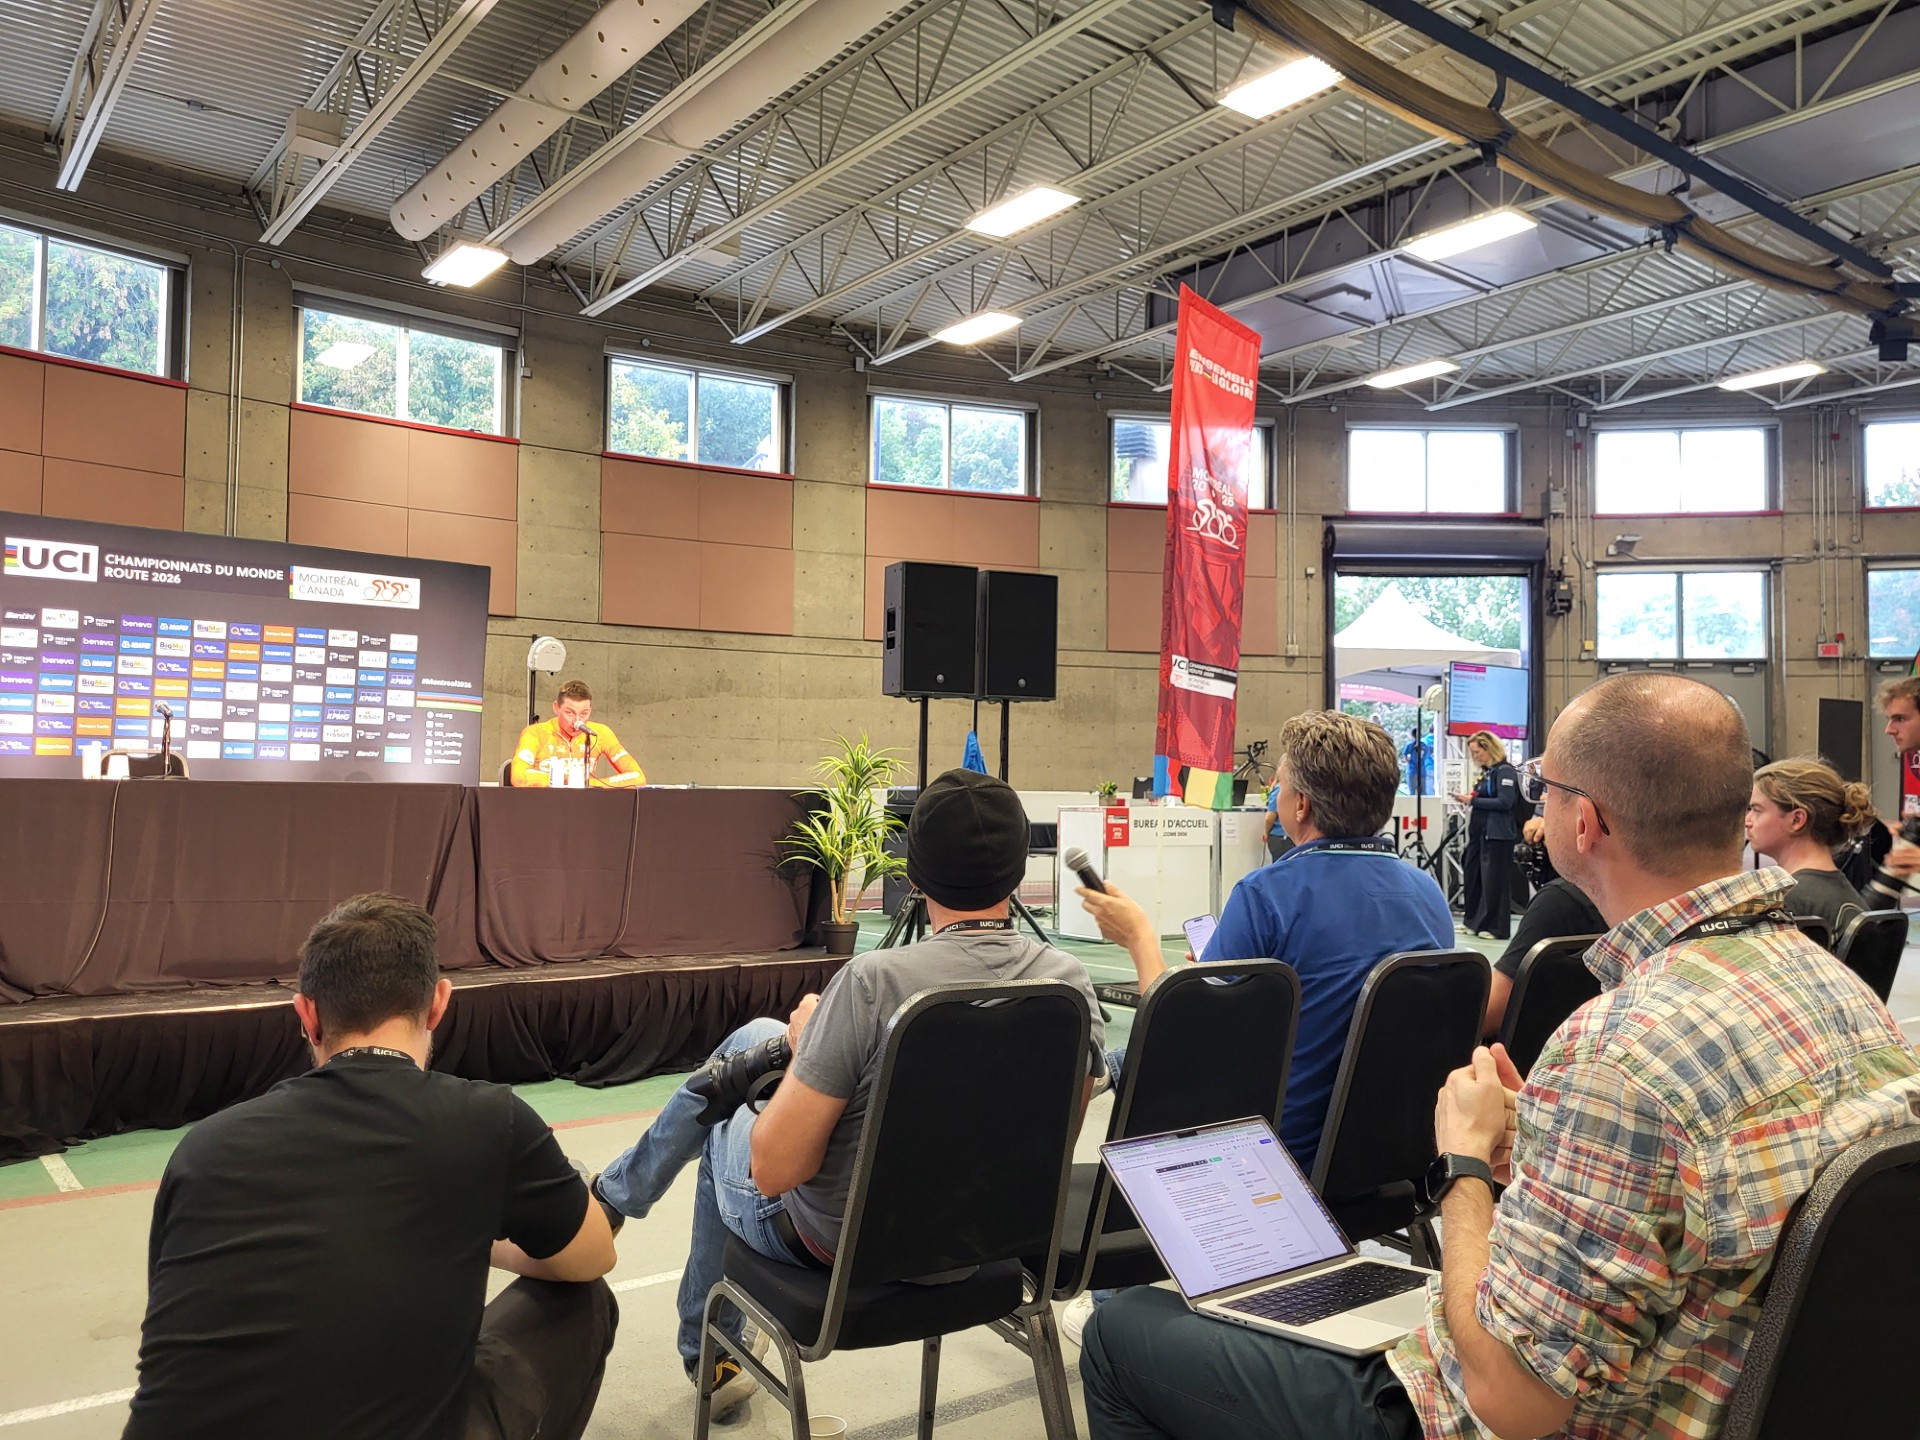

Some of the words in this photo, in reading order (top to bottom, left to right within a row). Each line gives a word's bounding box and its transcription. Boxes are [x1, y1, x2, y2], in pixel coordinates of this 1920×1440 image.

[22, 546, 90, 574] UCI
[104, 553, 212, 575] CHAMPIONNATS
[215, 564, 233, 577] DU
[236, 566, 284, 581] MONDE
[104, 567, 149, 581] ROUTE
[152, 572, 181, 584] 2026
[298, 573, 360, 588] MONTRÉAL
[298, 585, 344, 598] CANADA
[122, 619, 153, 629] beneva
[82, 637, 114, 647] beneva
[42, 656, 74, 665] beneva
[1167, 819, 1209, 829] D'ACCUEIL
[1706, 921, 1729, 932] UCI
